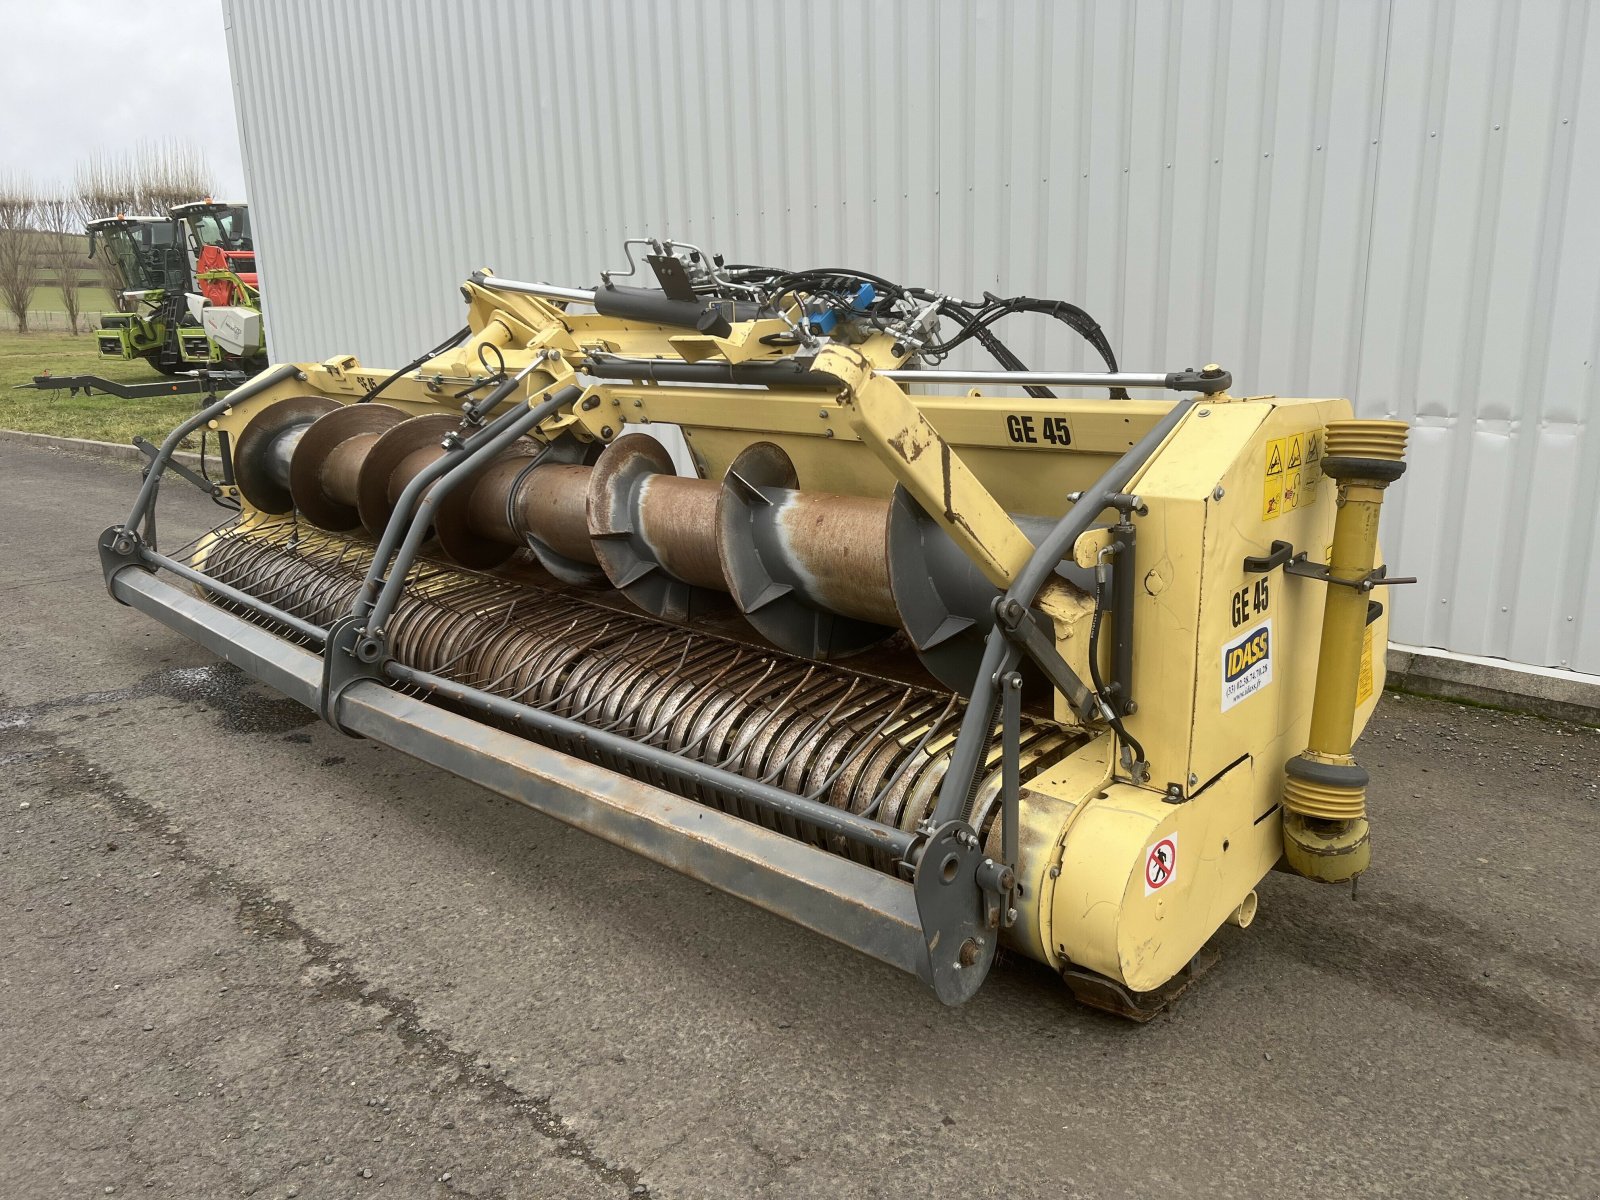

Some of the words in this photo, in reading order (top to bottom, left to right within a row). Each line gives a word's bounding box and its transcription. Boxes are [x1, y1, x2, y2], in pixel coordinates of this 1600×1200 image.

[1006, 415, 1037, 443] GE
[1043, 417, 1071, 445] 45
[1232, 587, 1249, 628] GE
[1253, 576, 1269, 614] 45
[1227, 632, 1268, 678] IDASS
